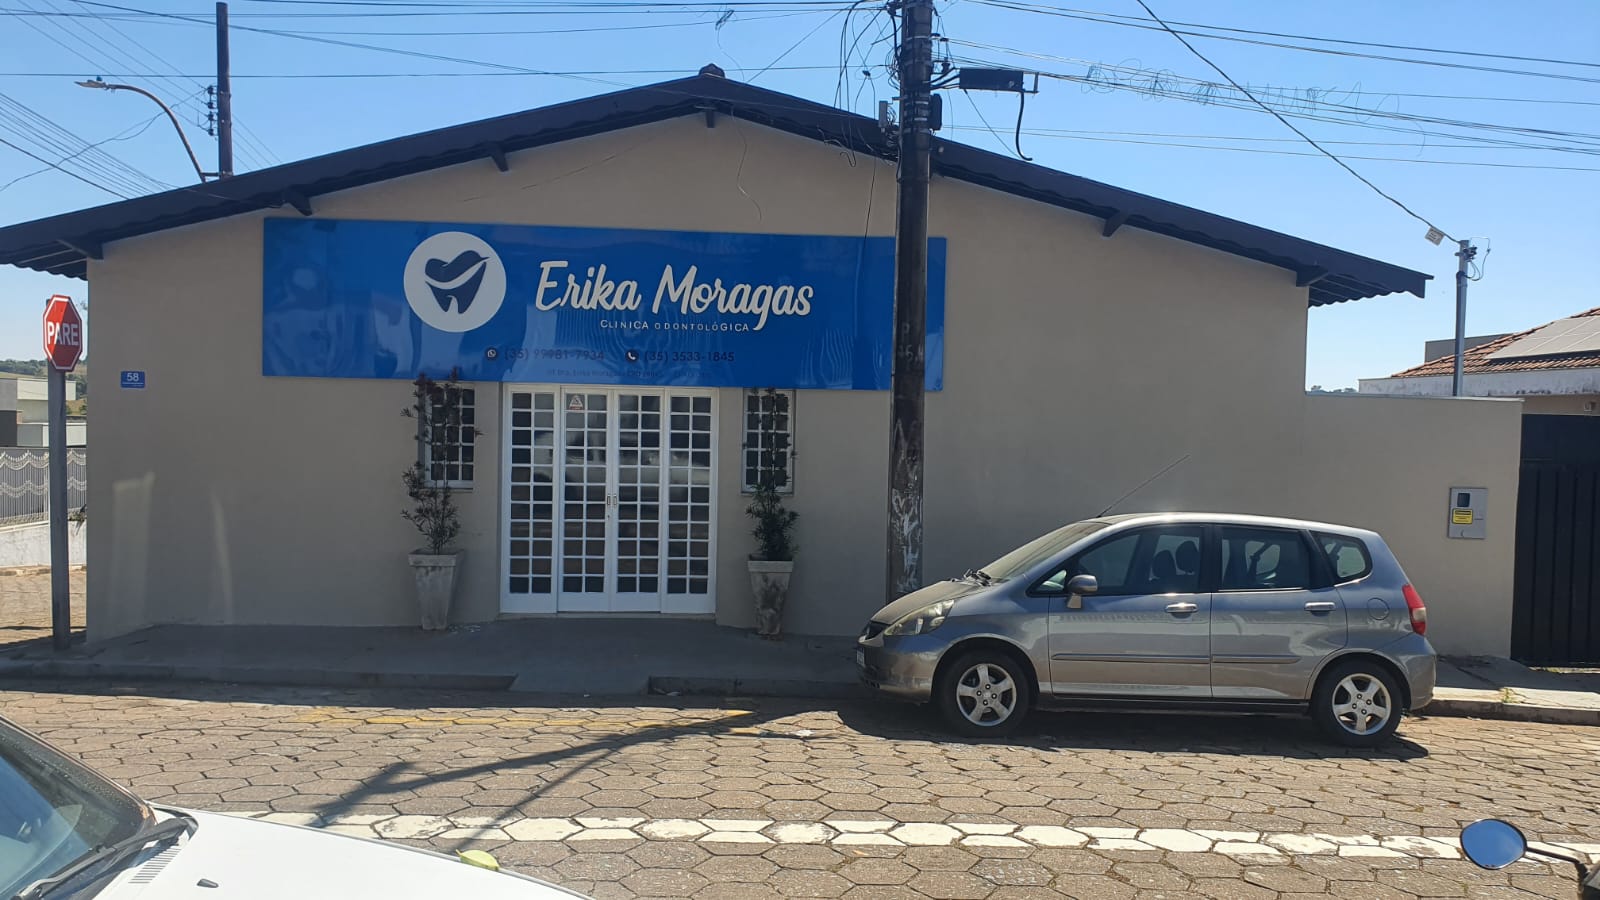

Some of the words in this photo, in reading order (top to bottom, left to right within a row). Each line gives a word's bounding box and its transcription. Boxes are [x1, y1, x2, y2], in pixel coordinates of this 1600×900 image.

[535, 260, 642, 311] Erika
[651, 264, 813, 332] Moragas
[47, 321, 79, 346] PARE
[505, 348, 529, 361] (35)
[644, 351, 669, 362] (35)
[672, 351, 735, 362] 3533-1845
[126, 372, 139, 382] 58
